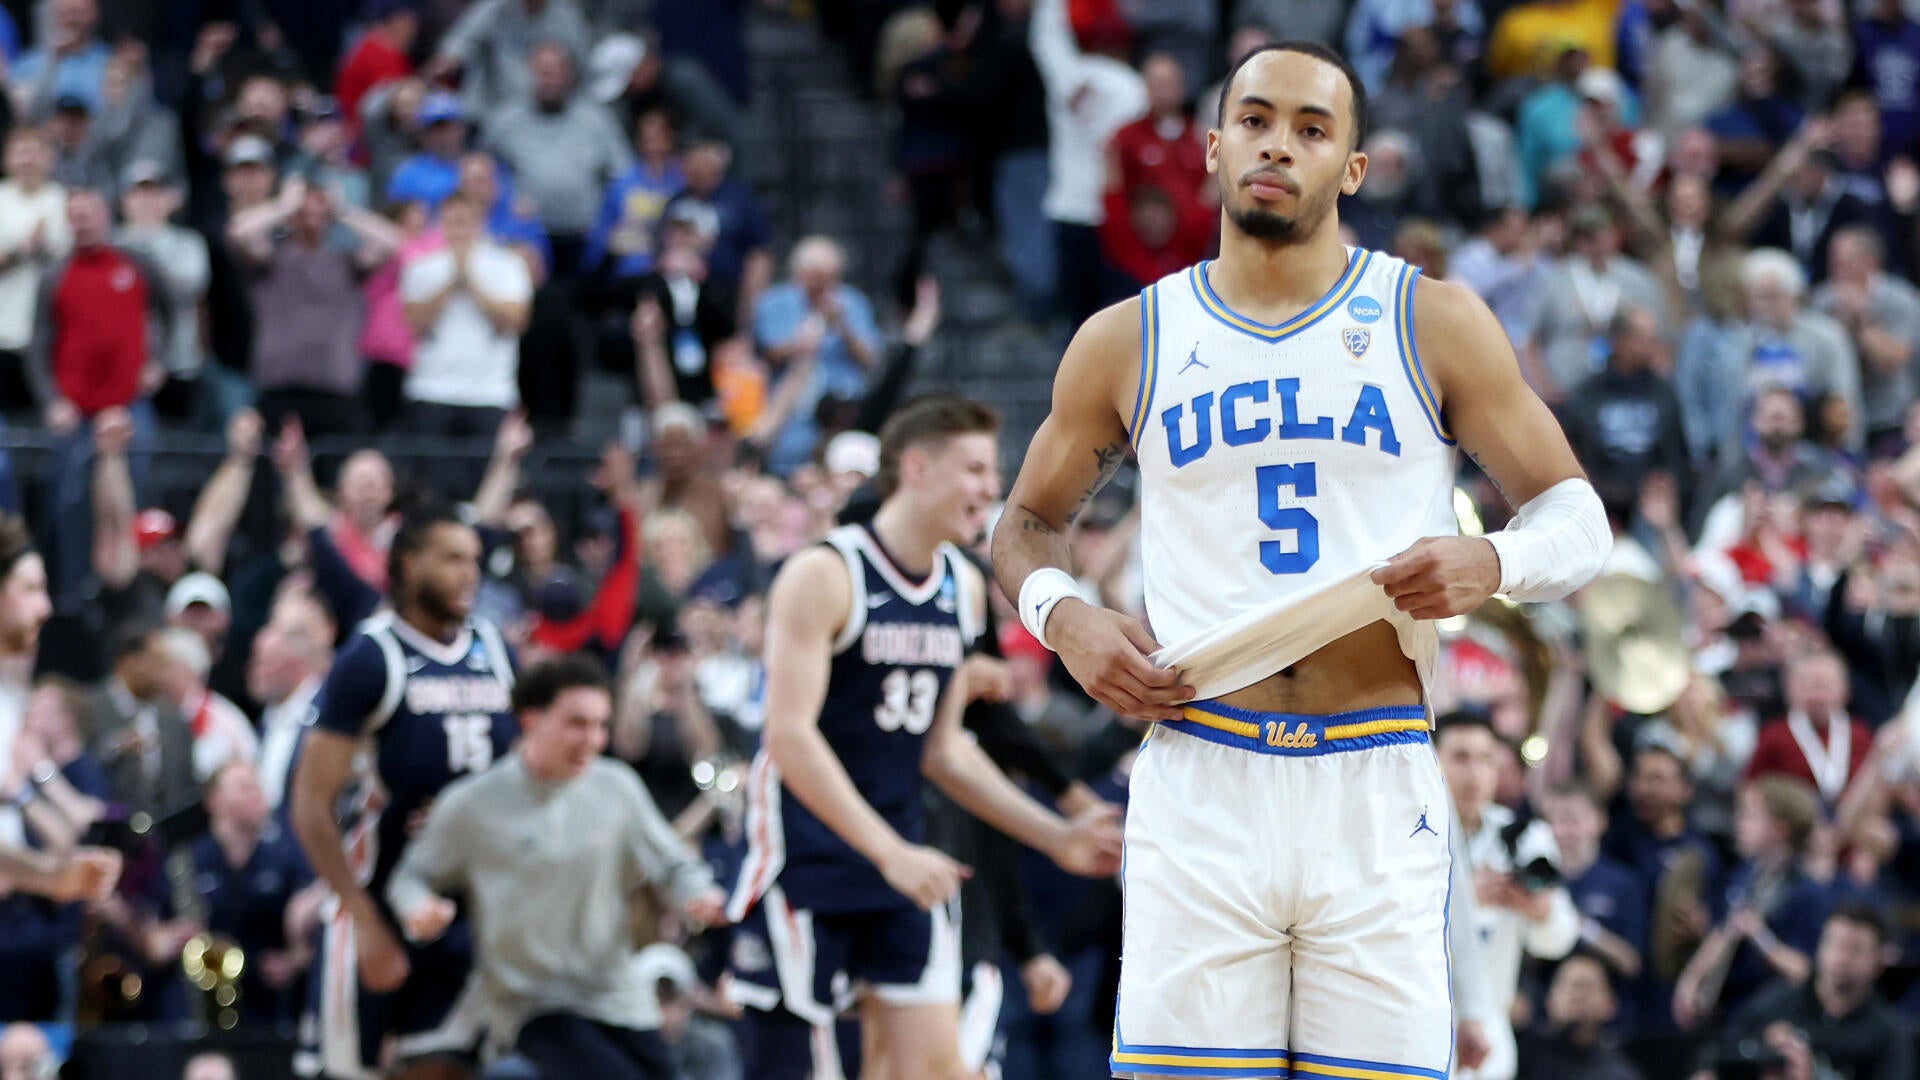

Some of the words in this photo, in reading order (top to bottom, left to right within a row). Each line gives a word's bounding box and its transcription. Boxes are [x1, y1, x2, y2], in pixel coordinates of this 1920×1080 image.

[1352, 307, 1380, 317] NCAA
[1343, 328, 1369, 346] PAC
[1350, 340, 1365, 352] 12
[1161, 377, 1401, 469] UCLA
[1255, 461, 1320, 575] 5
[873, 667, 939, 735] 33
[441, 712, 493, 773] 15
[1266, 721, 1318, 748] Ucla
